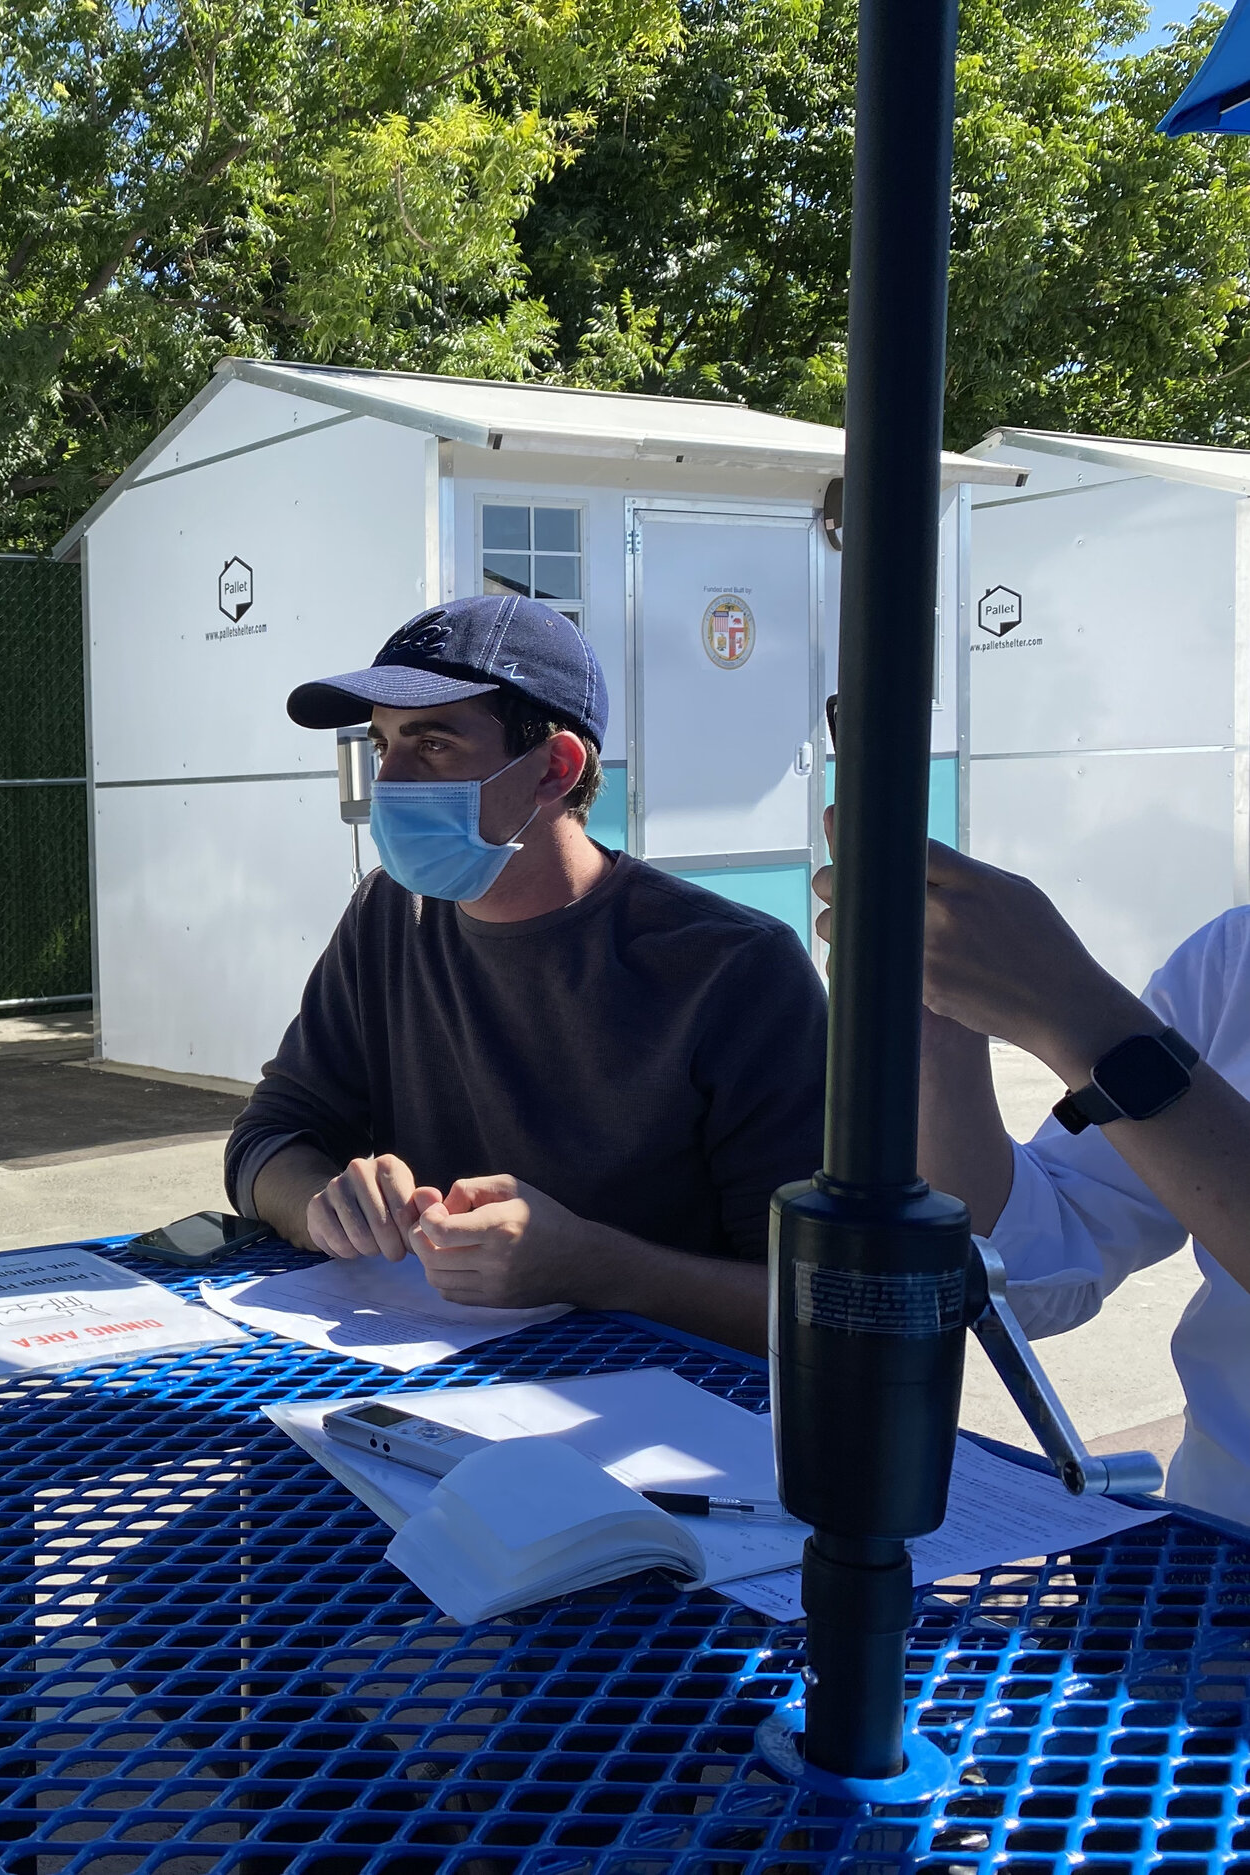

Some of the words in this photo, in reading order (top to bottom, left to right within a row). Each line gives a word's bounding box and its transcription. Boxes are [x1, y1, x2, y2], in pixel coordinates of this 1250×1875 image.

[224, 581, 248, 595] Pallet
[985, 604, 1015, 616] Pallet
[205, 624, 268, 643] www.palletshelter.com
[970, 638, 1043, 653] ww.palletshelter.com
[46, 1261, 81, 1270] UNA
[19, 1273, 90, 1288] PERSON
[83, 1319, 165, 1337] DINING
[9, 1330, 79, 1349] AREA
